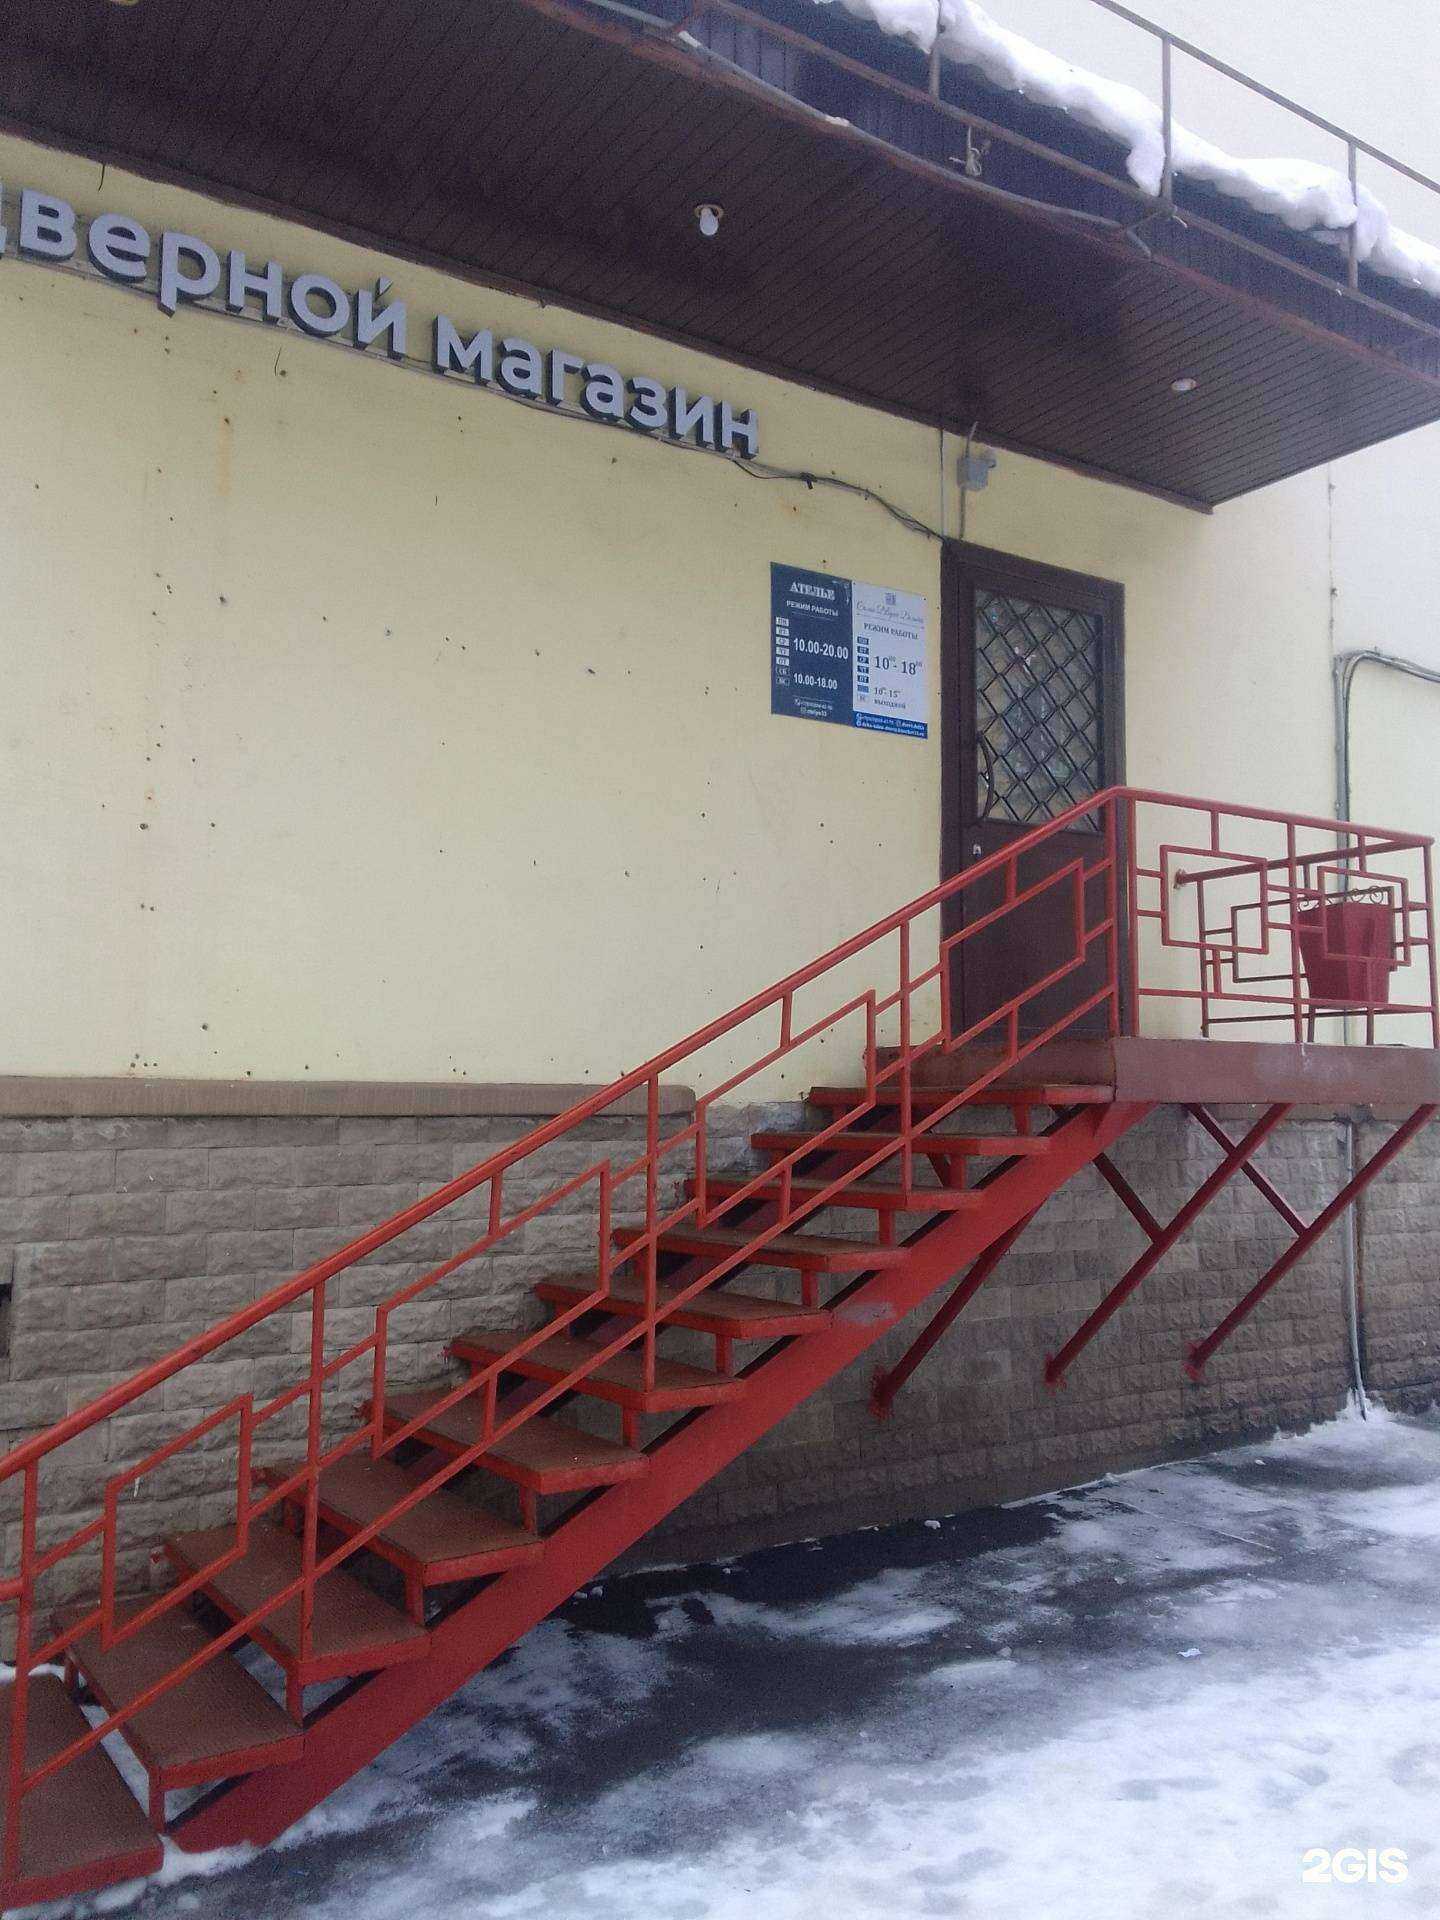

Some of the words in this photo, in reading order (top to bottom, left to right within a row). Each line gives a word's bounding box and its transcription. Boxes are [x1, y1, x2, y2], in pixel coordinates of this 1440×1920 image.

[0, 182, 408, 360] верной
[790, 581, 835, 601] АТЕЛЬЕ
[787, 600, 811, 611] РЕЖИМ
[811, 605, 839, 617] РАБОТЫ
[864, 622, 889, 634] РЕЖИМ
[891, 628, 918, 639] РАБОТЫ
[794, 638, 848, 659] 10.00-20.00
[794, 673, 838, 689] 10.00-18.00
